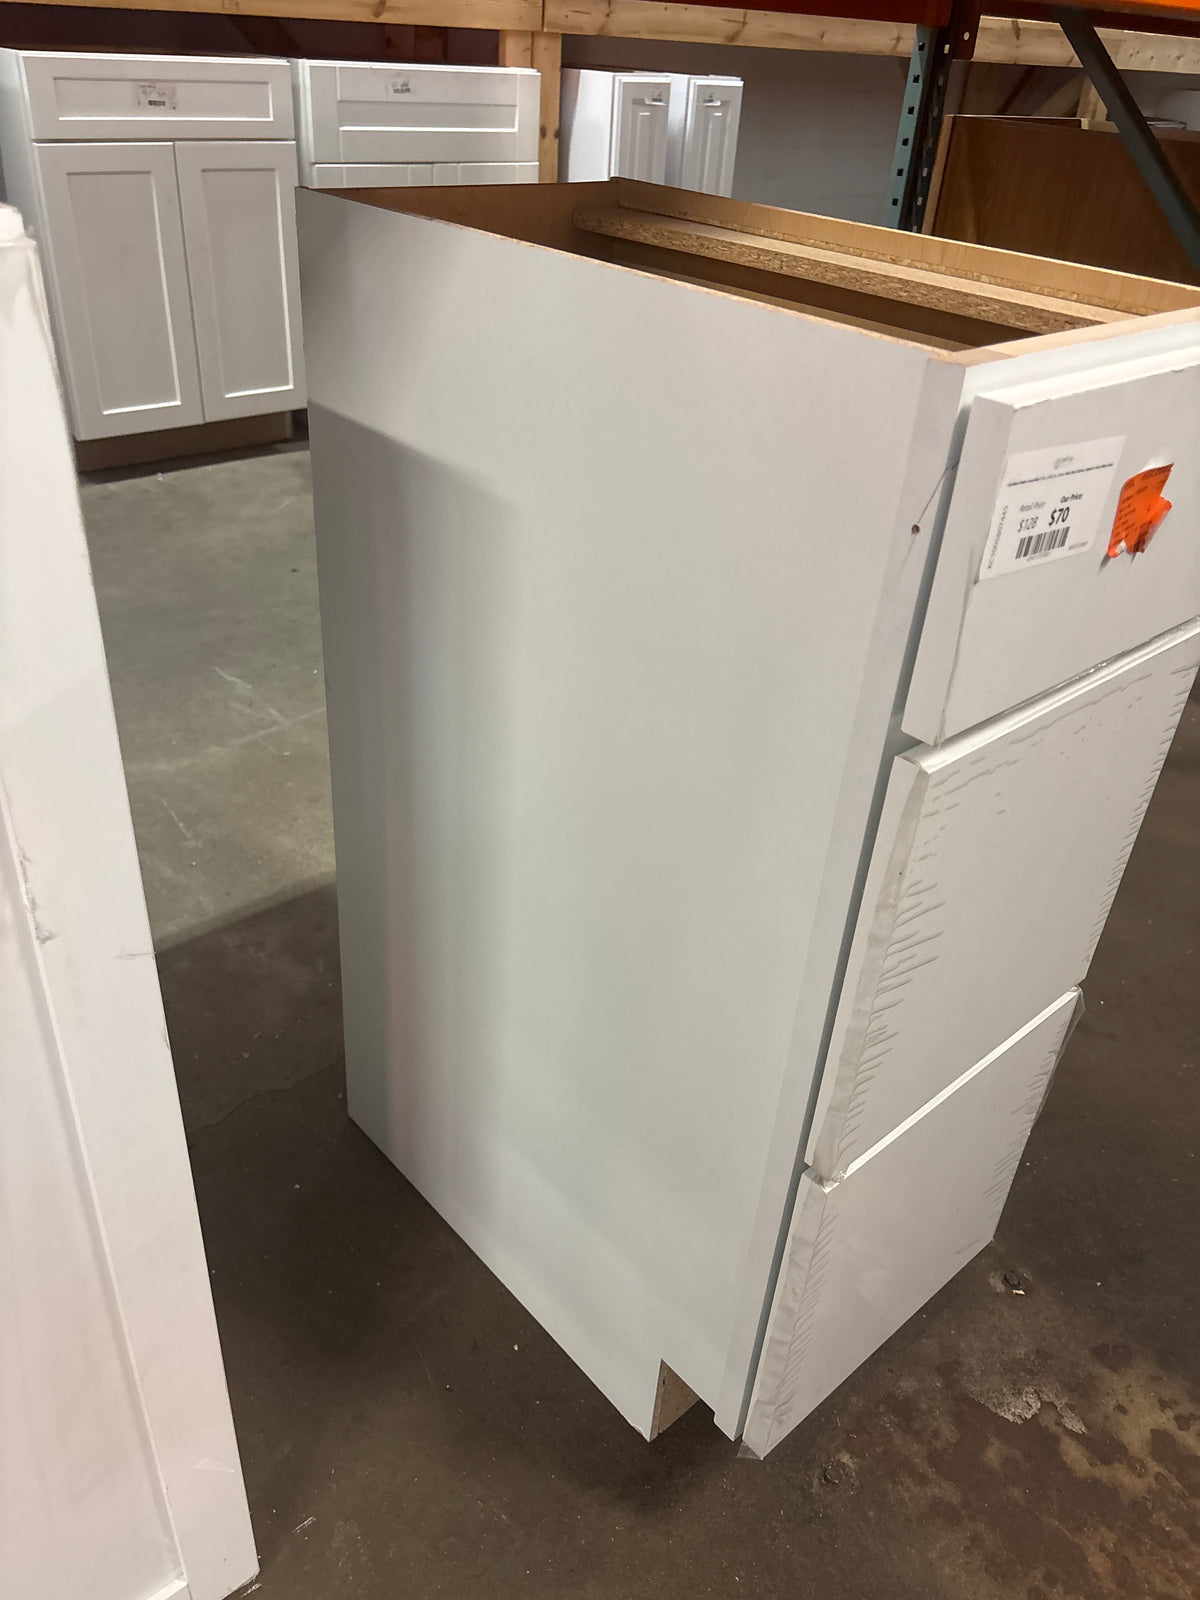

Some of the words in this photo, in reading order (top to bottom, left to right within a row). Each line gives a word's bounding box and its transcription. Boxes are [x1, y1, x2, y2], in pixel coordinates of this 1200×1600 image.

[1060, 495, 1070, 503] Our
[1017, 516, 1039, 532] $128
[1048, 506, 1070, 527] $70
